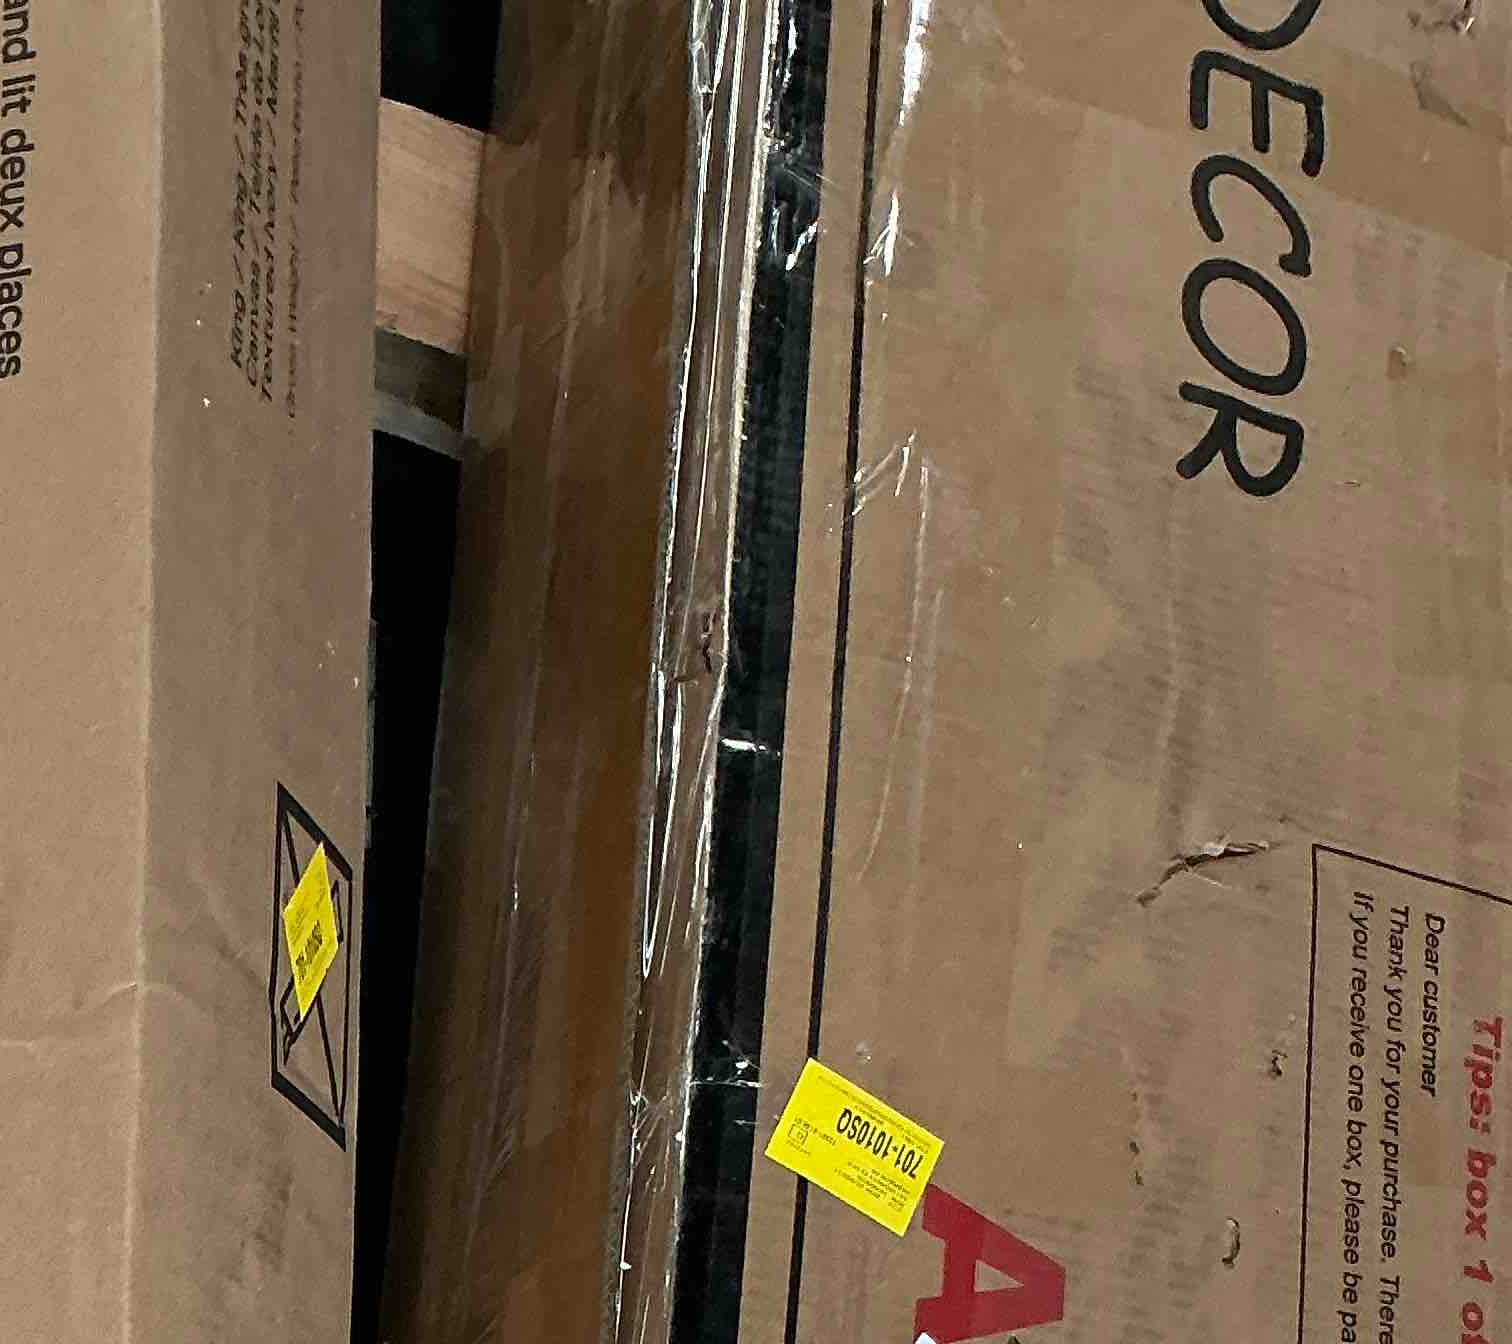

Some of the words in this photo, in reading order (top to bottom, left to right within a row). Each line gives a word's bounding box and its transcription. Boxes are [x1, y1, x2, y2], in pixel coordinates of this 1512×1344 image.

[1, 74, 36, 117] lit
[0, 129, 35, 232] deux
[1353, 890, 1374, 912] If
[1349, 911, 1368, 961] you
[1387, 905, 1409, 981] Thank
[1425, 912, 1445, 976] Dear
[1349, 966, 1370, 1058] receive
[1384, 984, 1403, 1033] you
[1421, 979, 1440, 1098] customer
[1385, 1038, 1406, 1075] for
[1464, 1016, 1503, 1134] Tips:
[1347, 1063, 1364, 1113] one
[1381, 1077, 1401, 1138] your
[1343, 1118, 1367, 1170] box,
[1340, 1177, 1364, 1265] please
[1379, 1139, 1402, 1262] purchase.
[1464, 1148, 1496, 1241] box
[912, 1183, 1065, 1344] A
[1341, 1271, 1363, 1305] be
[1464, 1259, 1494, 1284] 1
